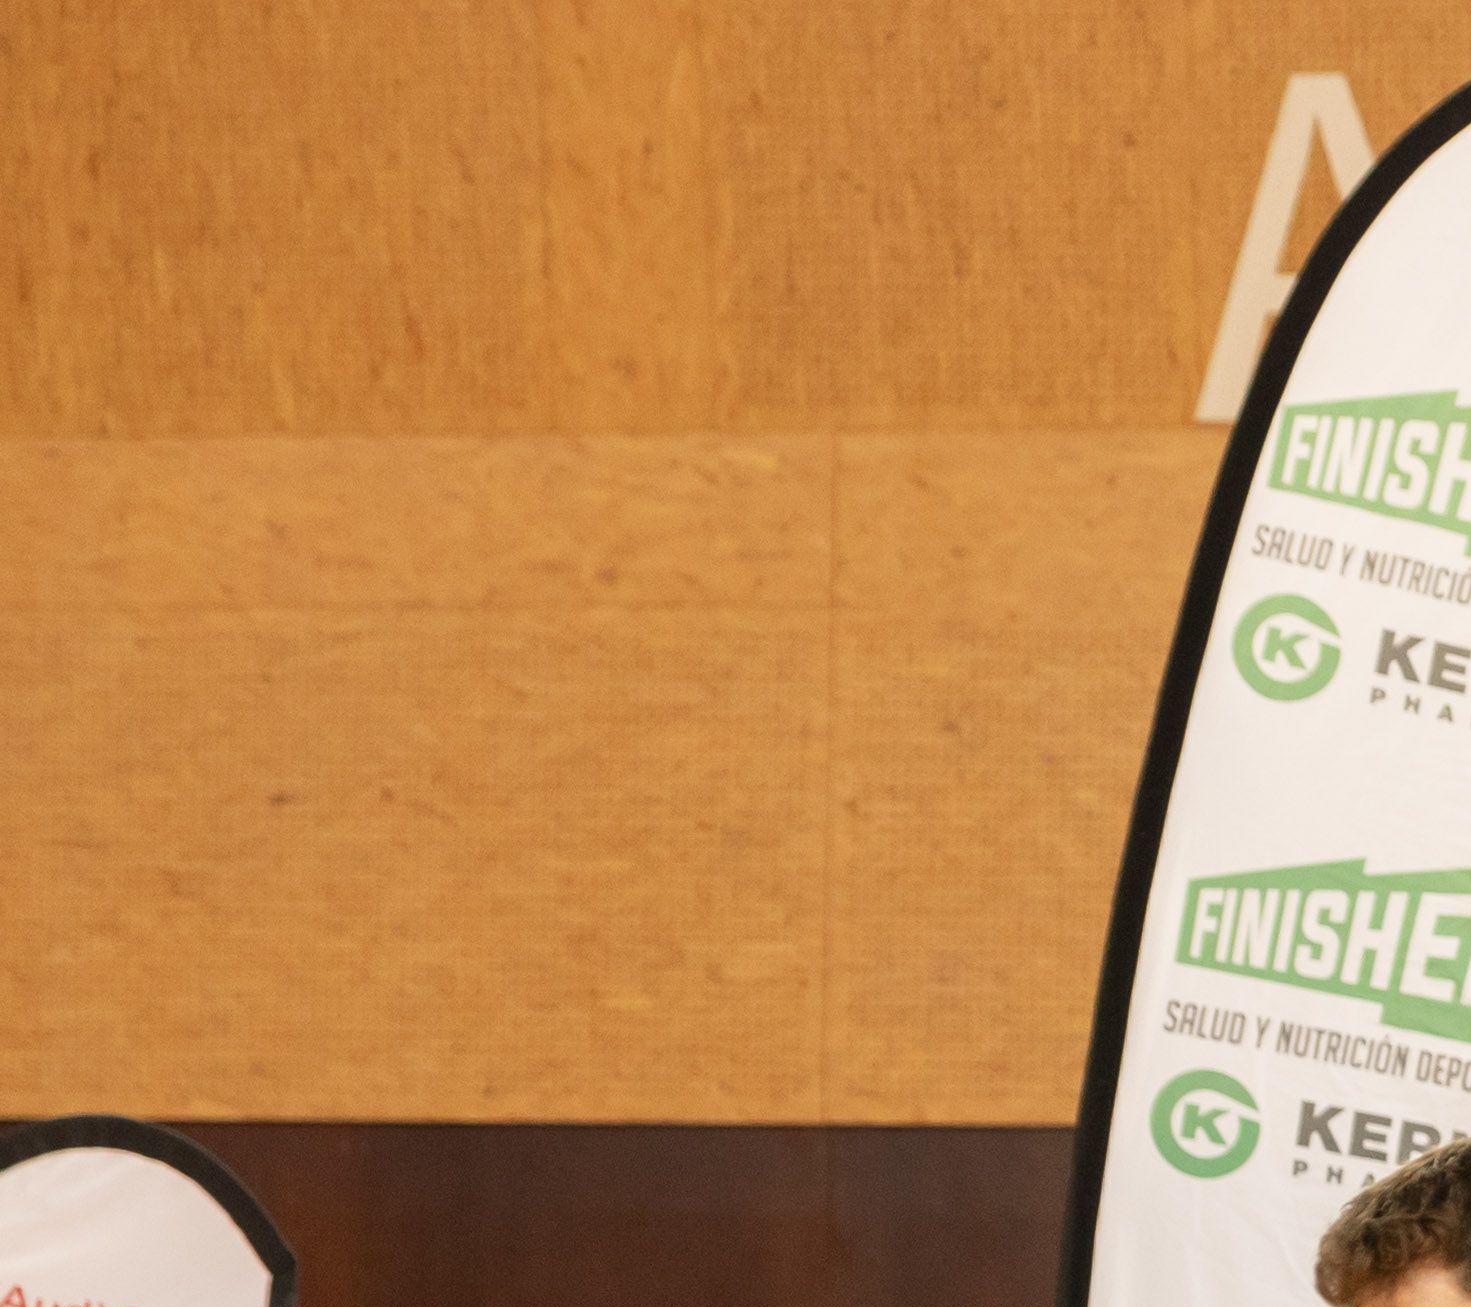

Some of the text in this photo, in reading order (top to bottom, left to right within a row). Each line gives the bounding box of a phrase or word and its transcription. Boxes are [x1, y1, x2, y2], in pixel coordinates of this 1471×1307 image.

[1252, 525, 1334, 571] SALUD
[1339, 545, 1355, 576] Y
[1163, 999, 1247, 1043] SALUD
[1255, 1017, 1271, 1048] Y
[1276, 1018, 1411, 1078] NUTRICIÓN
[1297, 1101, 1469, 1165] KER
